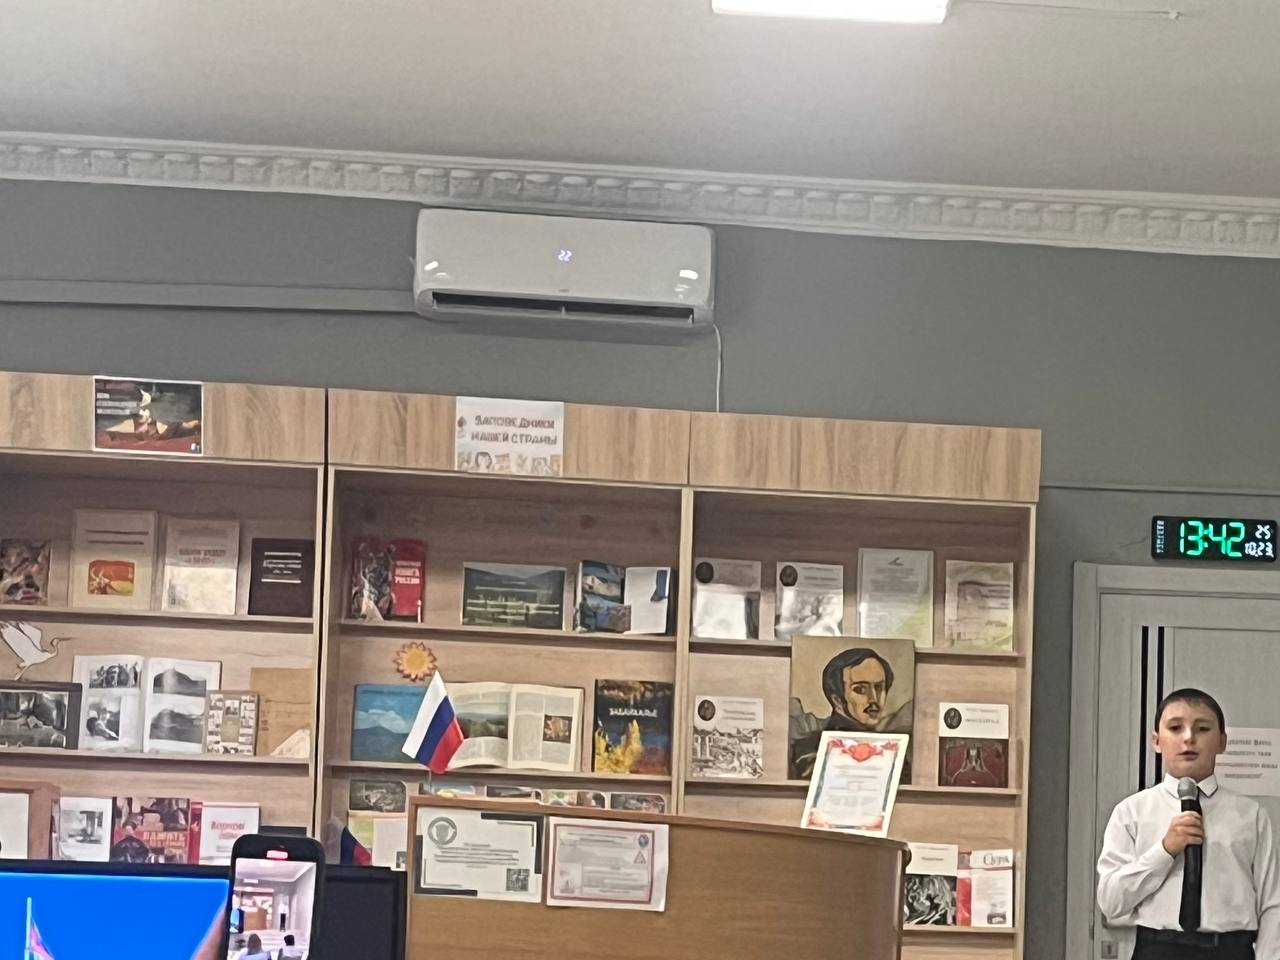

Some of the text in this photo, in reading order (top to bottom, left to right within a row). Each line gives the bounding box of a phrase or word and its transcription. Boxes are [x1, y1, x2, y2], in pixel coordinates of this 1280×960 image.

[471, 431, 558, 446] НАШЕЙ СТРАНЫ
[1179, 520, 1246, 557] 13:42
